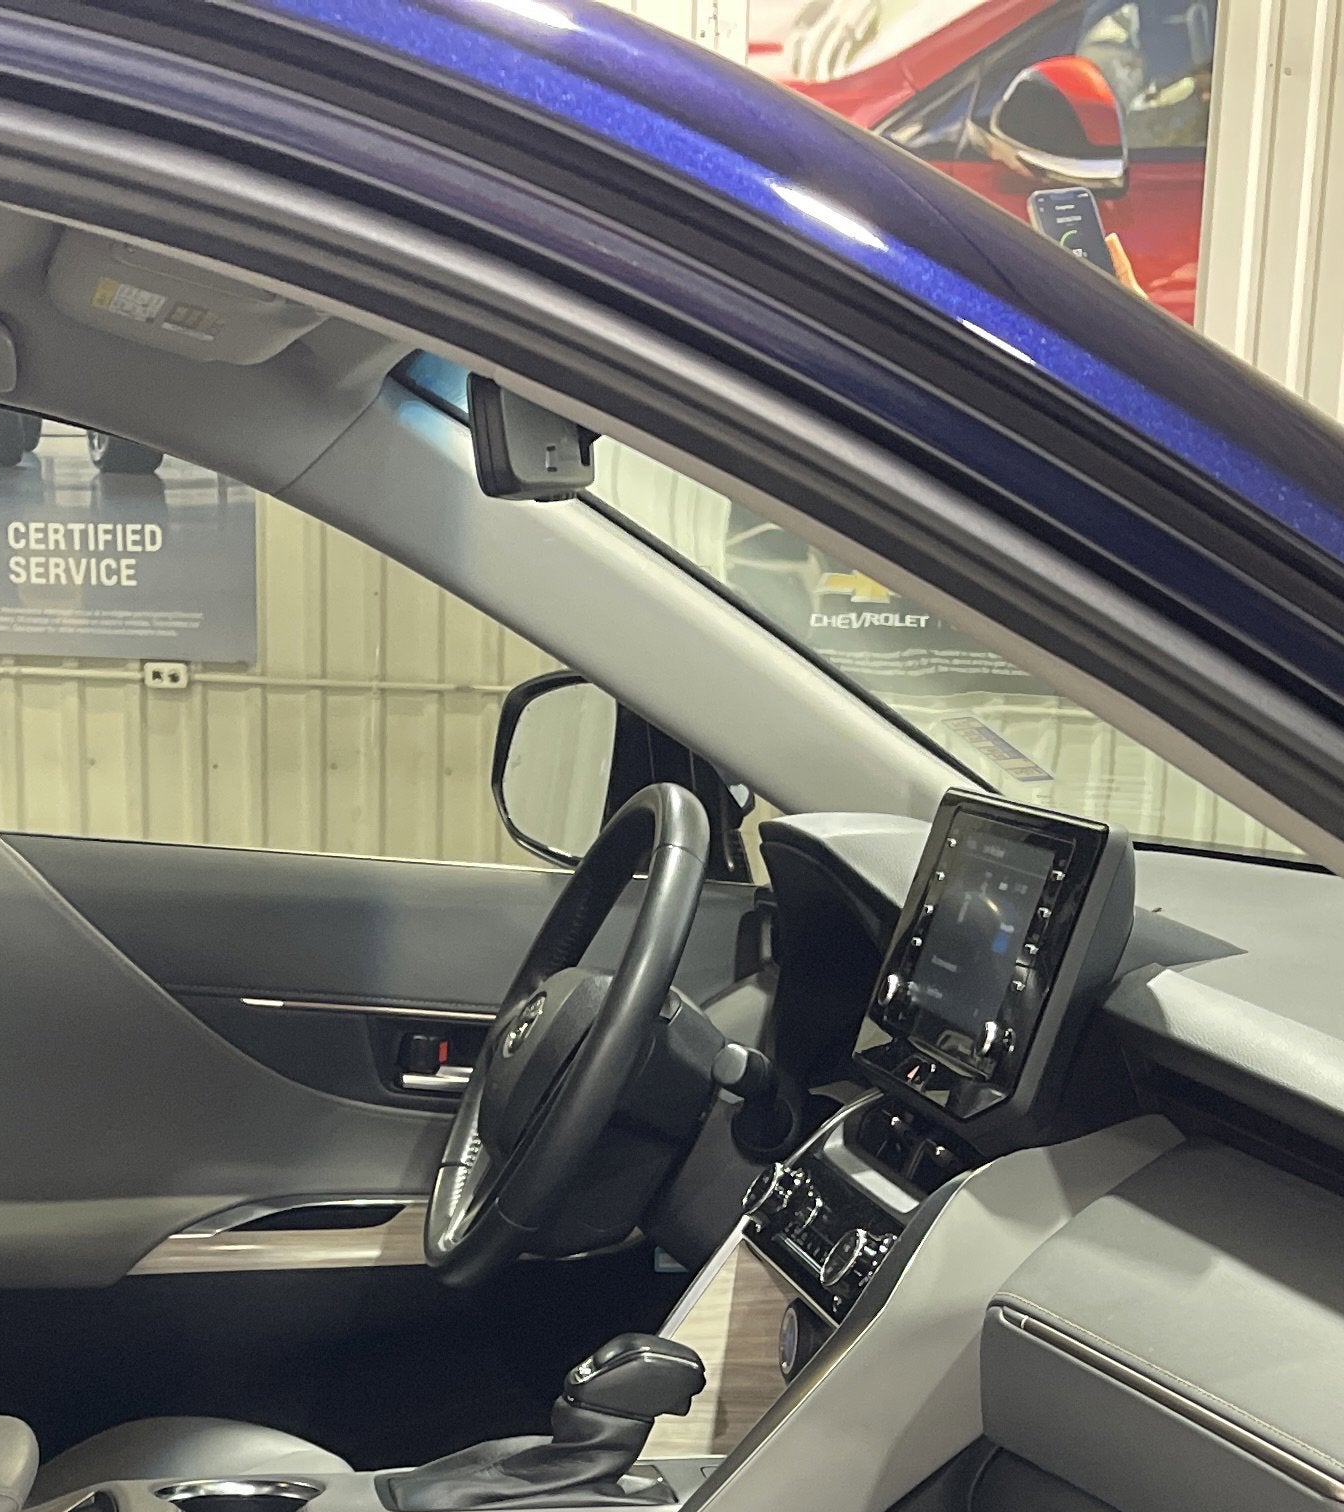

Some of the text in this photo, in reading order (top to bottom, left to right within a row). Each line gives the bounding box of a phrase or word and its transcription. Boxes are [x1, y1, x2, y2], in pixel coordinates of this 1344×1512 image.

[7, 521, 163, 552] CERTIFIED
[9, 556, 138, 587] SERVICE
[809, 611, 930, 629] CHEVROLET
